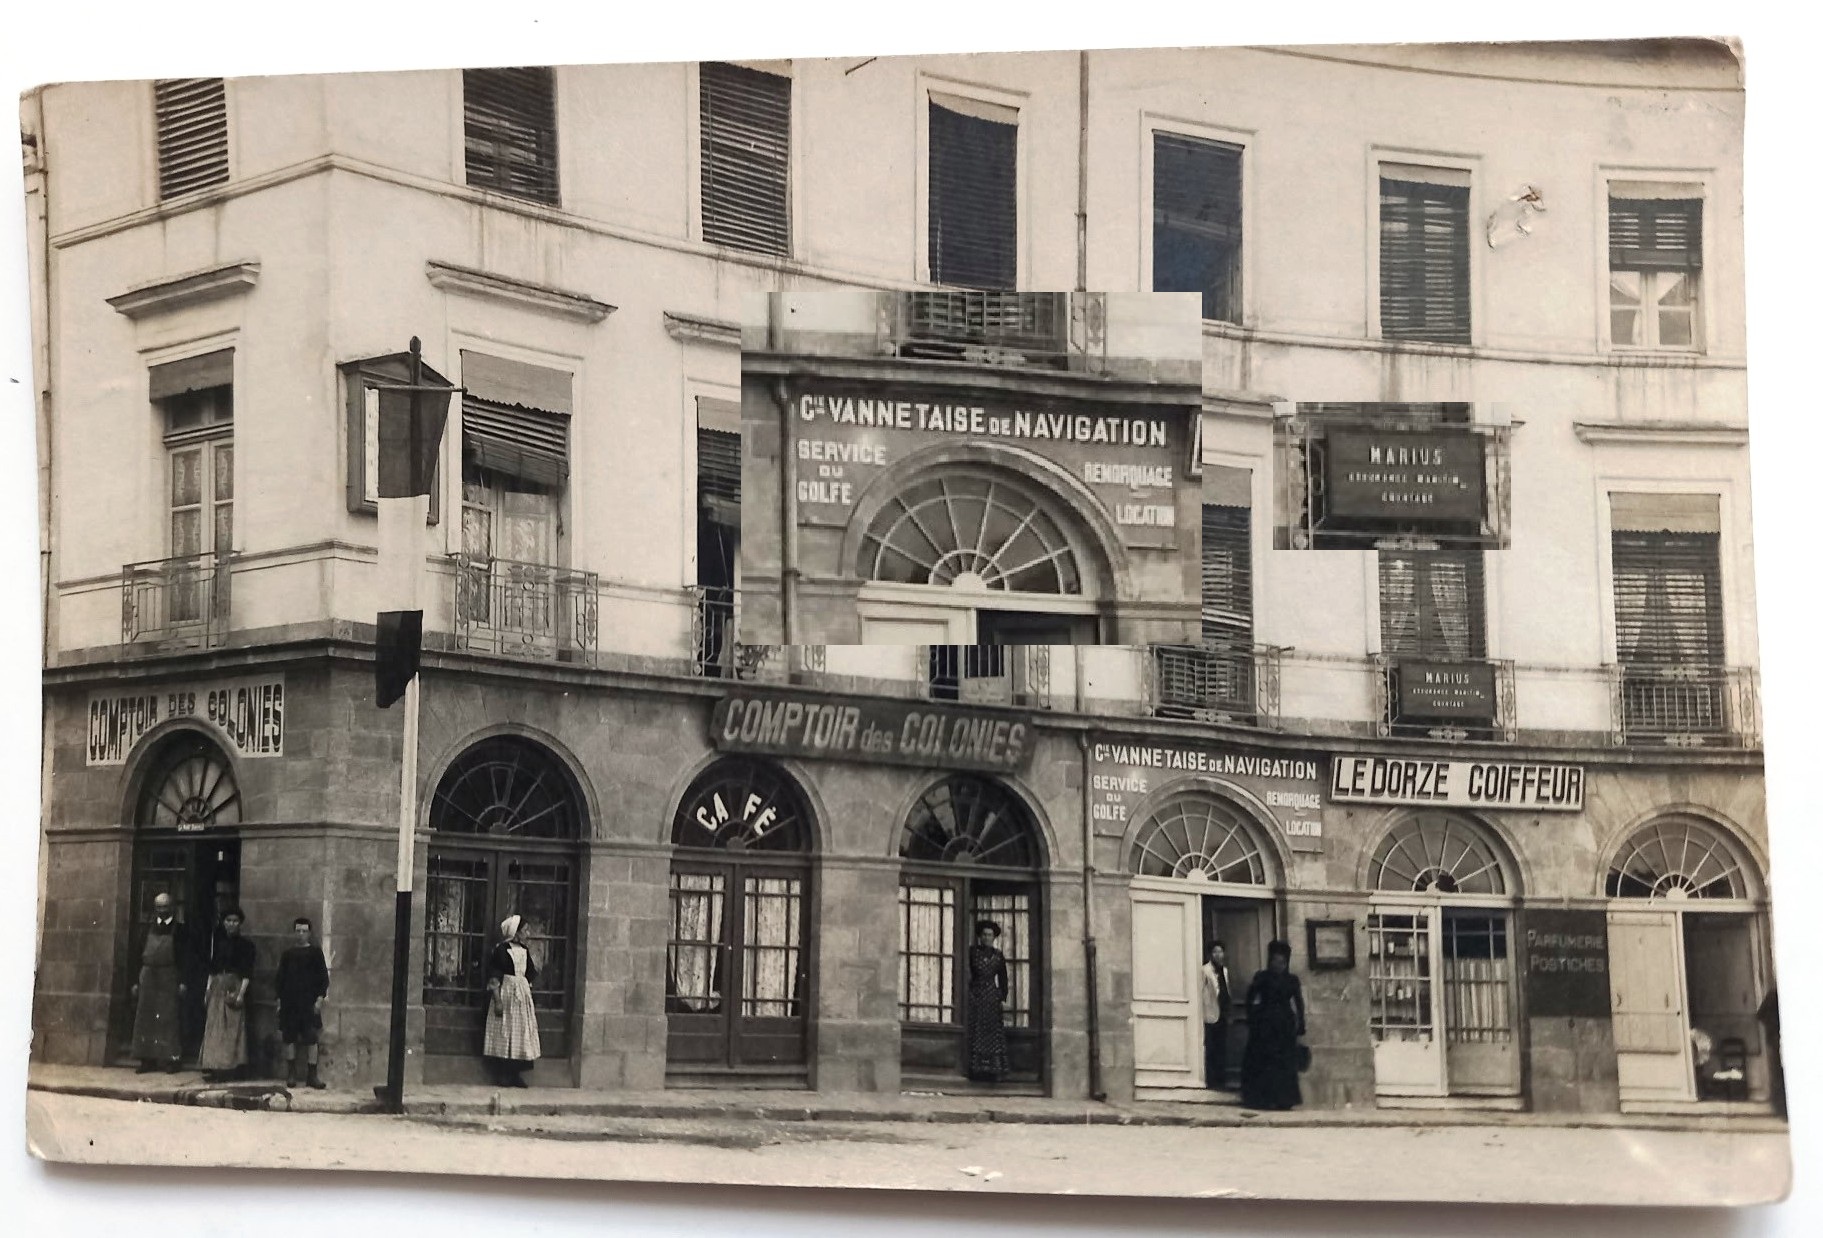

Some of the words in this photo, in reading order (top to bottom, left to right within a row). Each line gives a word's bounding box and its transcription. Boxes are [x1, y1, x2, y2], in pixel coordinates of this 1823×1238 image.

[828, 397, 985, 433] VANNETAISE
[989, 417, 1011, 435] DE
[1015, 410, 1166, 446] NAVIGATION
[799, 438, 886, 465] SERVICE
[1370, 446, 1442, 465] MARIUS
[799, 481, 851, 504] GOLFE
[1425, 671, 1470, 684] MARIUS
[90, 695, 158, 761] COMPTOIR
[168, 692, 196, 717] DES
[208, 684, 284, 754] COLONIES
[722, 699, 860, 749] COMPTOIR
[860, 721, 895, 752] des
[899, 711, 1026, 764] COLONIES
[1111, 745, 1207, 772] VANNETAISE
[1209, 759, 1223, 772] DE
[1224, 754, 1317, 780] NAVIGATION
[1093, 775, 1147, 793] SERVICE
[1467, 764, 1582, 806] COIFFEUR
[1092, 804, 1126, 821] GOLFE
